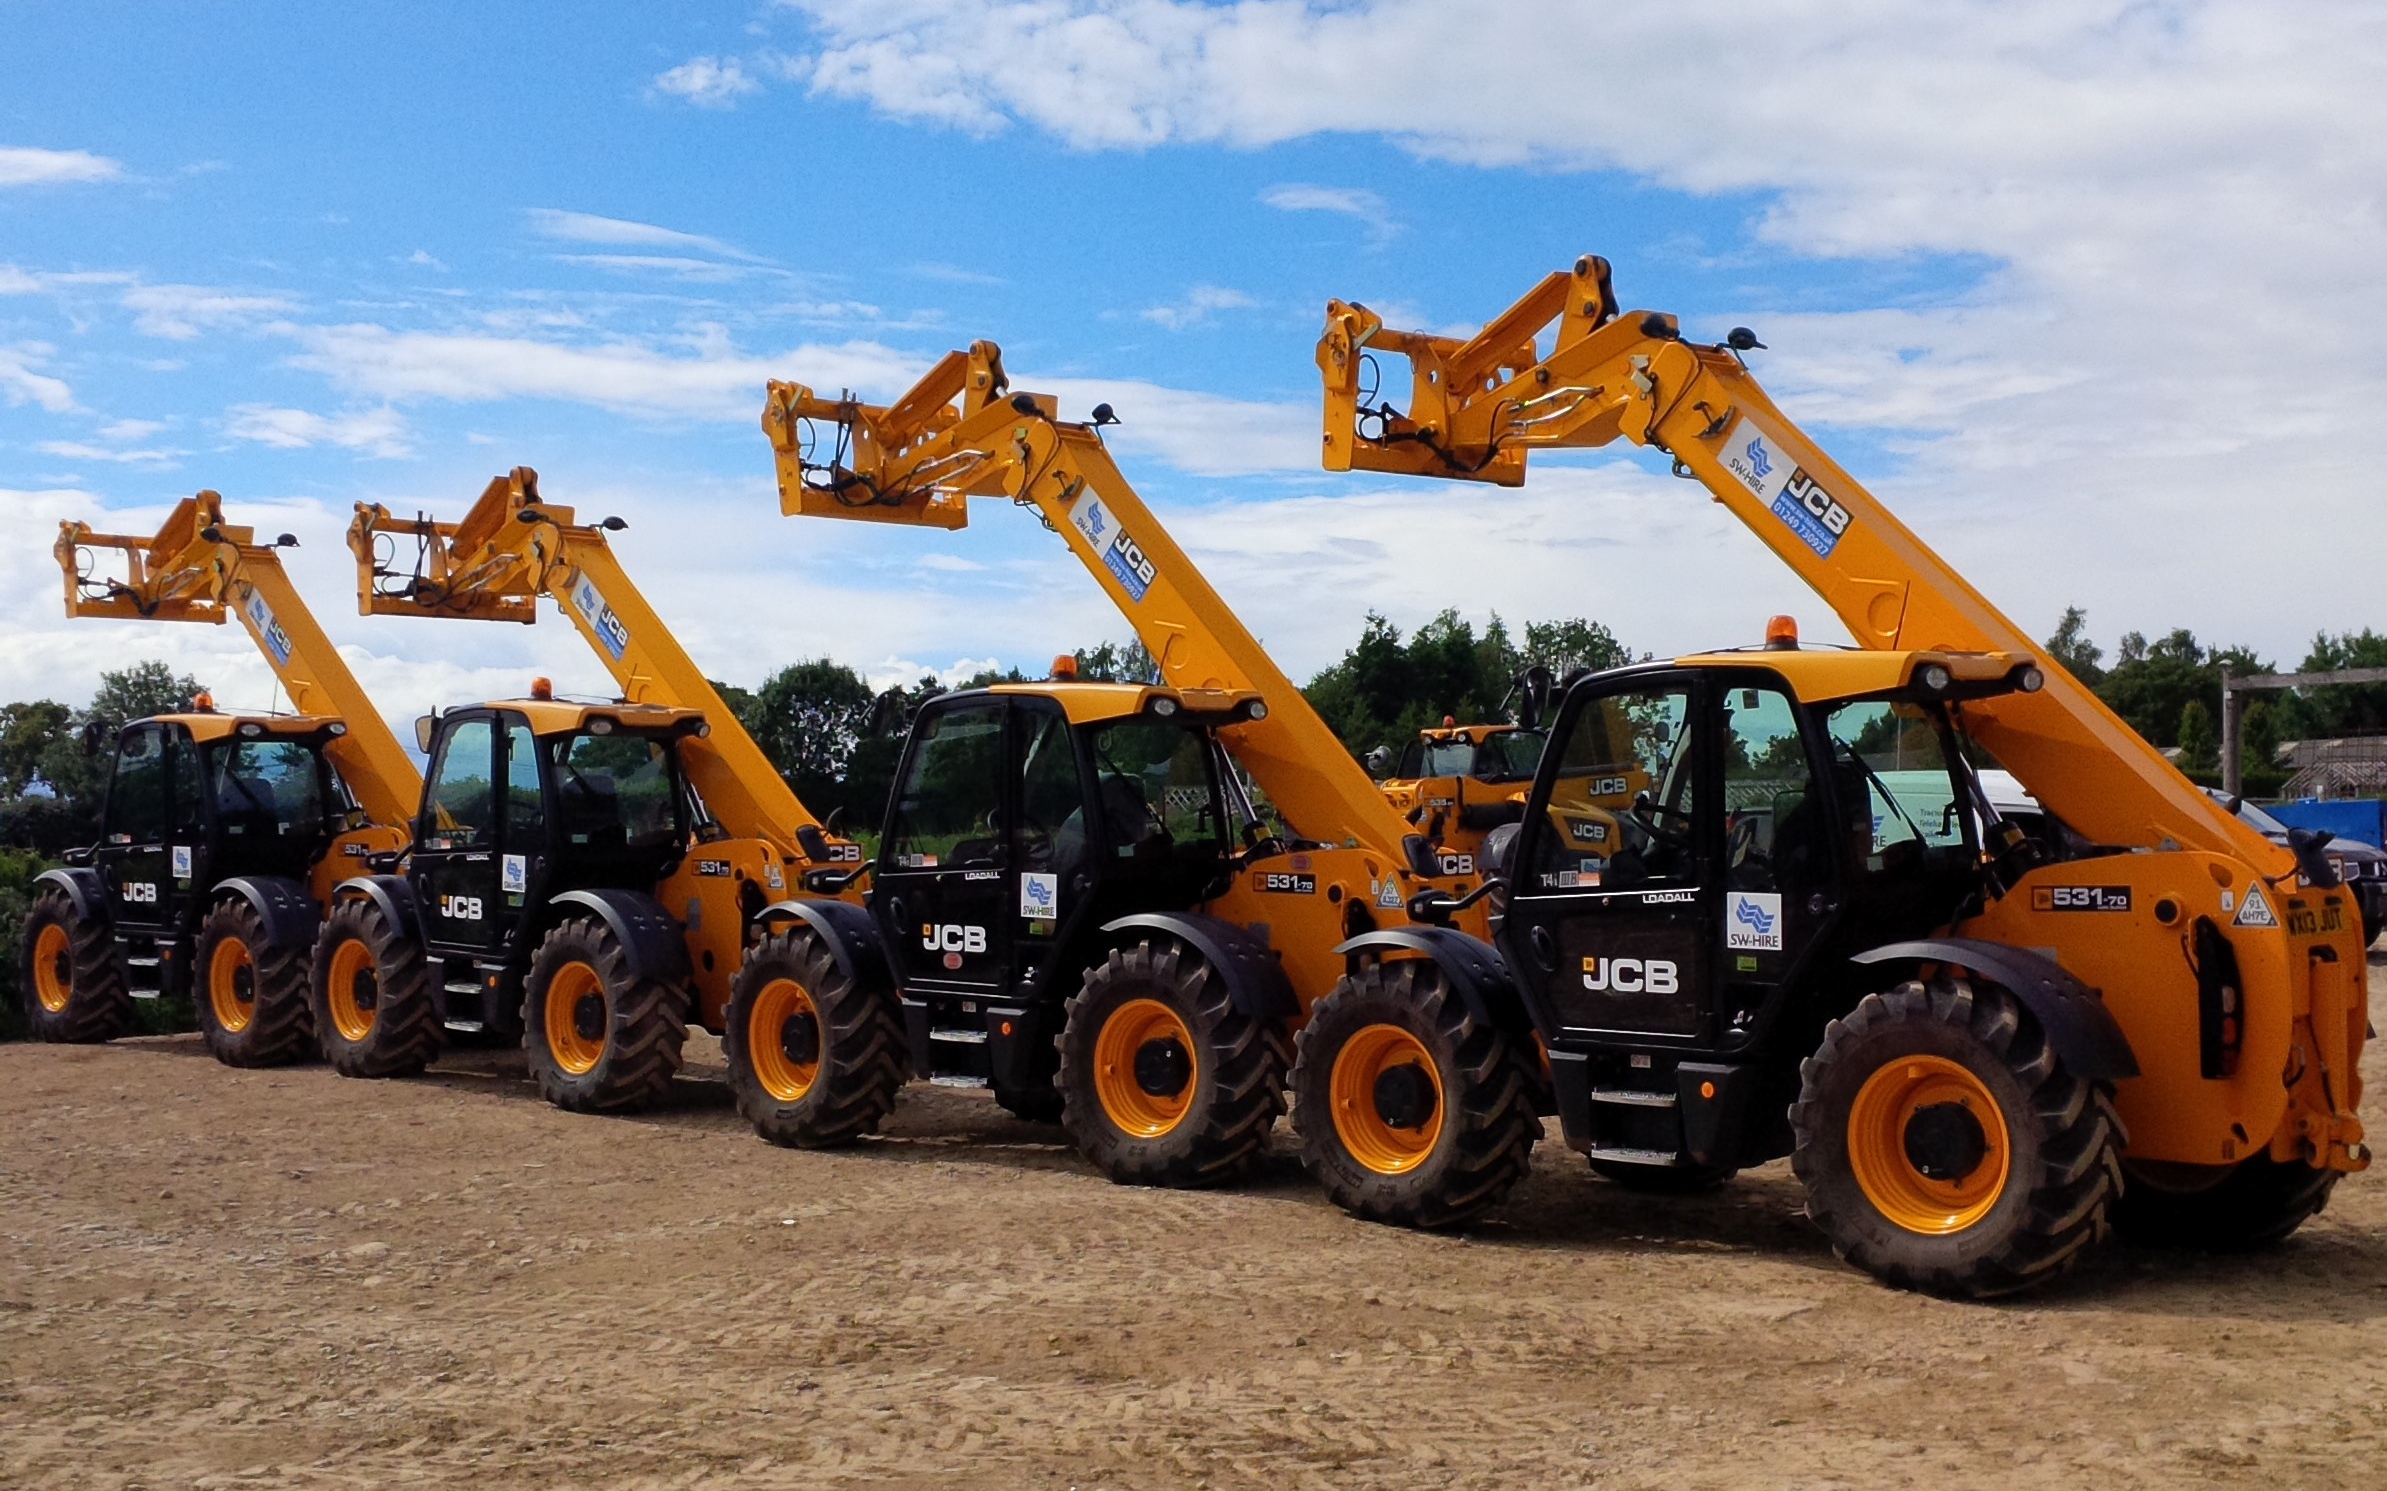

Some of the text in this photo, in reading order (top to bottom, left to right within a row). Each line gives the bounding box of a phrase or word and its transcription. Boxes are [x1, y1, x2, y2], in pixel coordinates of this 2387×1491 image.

[1729, 458, 1766, 495] SW-HIRE
[1787, 478, 1849, 535] JCB
[1773, 500, 1829, 556] 01249 730927
[1115, 538, 1155, 585] JCB
[270, 623, 292, 654] JCB
[602, 610, 628, 647] JCB
[1590, 778, 1627, 795] JCB
[1573, 824, 1605, 839] JCB
[828, 845, 860, 861] CB
[122, 882, 157, 902] JCB
[1267, 874, 1313, 889] 531-70
[1642, 892, 1695, 903] LOADALL
[2053, 887, 2128, 906] 531-70
[2248, 899, 2261, 910] 91
[441, 895, 482, 920] JCB
[2241, 910, 2268, 921] AH7E
[2320, 908, 2343, 931] JUT
[922, 924, 987, 953] JCB
[1729, 933, 1779, 948] SW-HIRE
[1583, 957, 1679, 994] JCB
